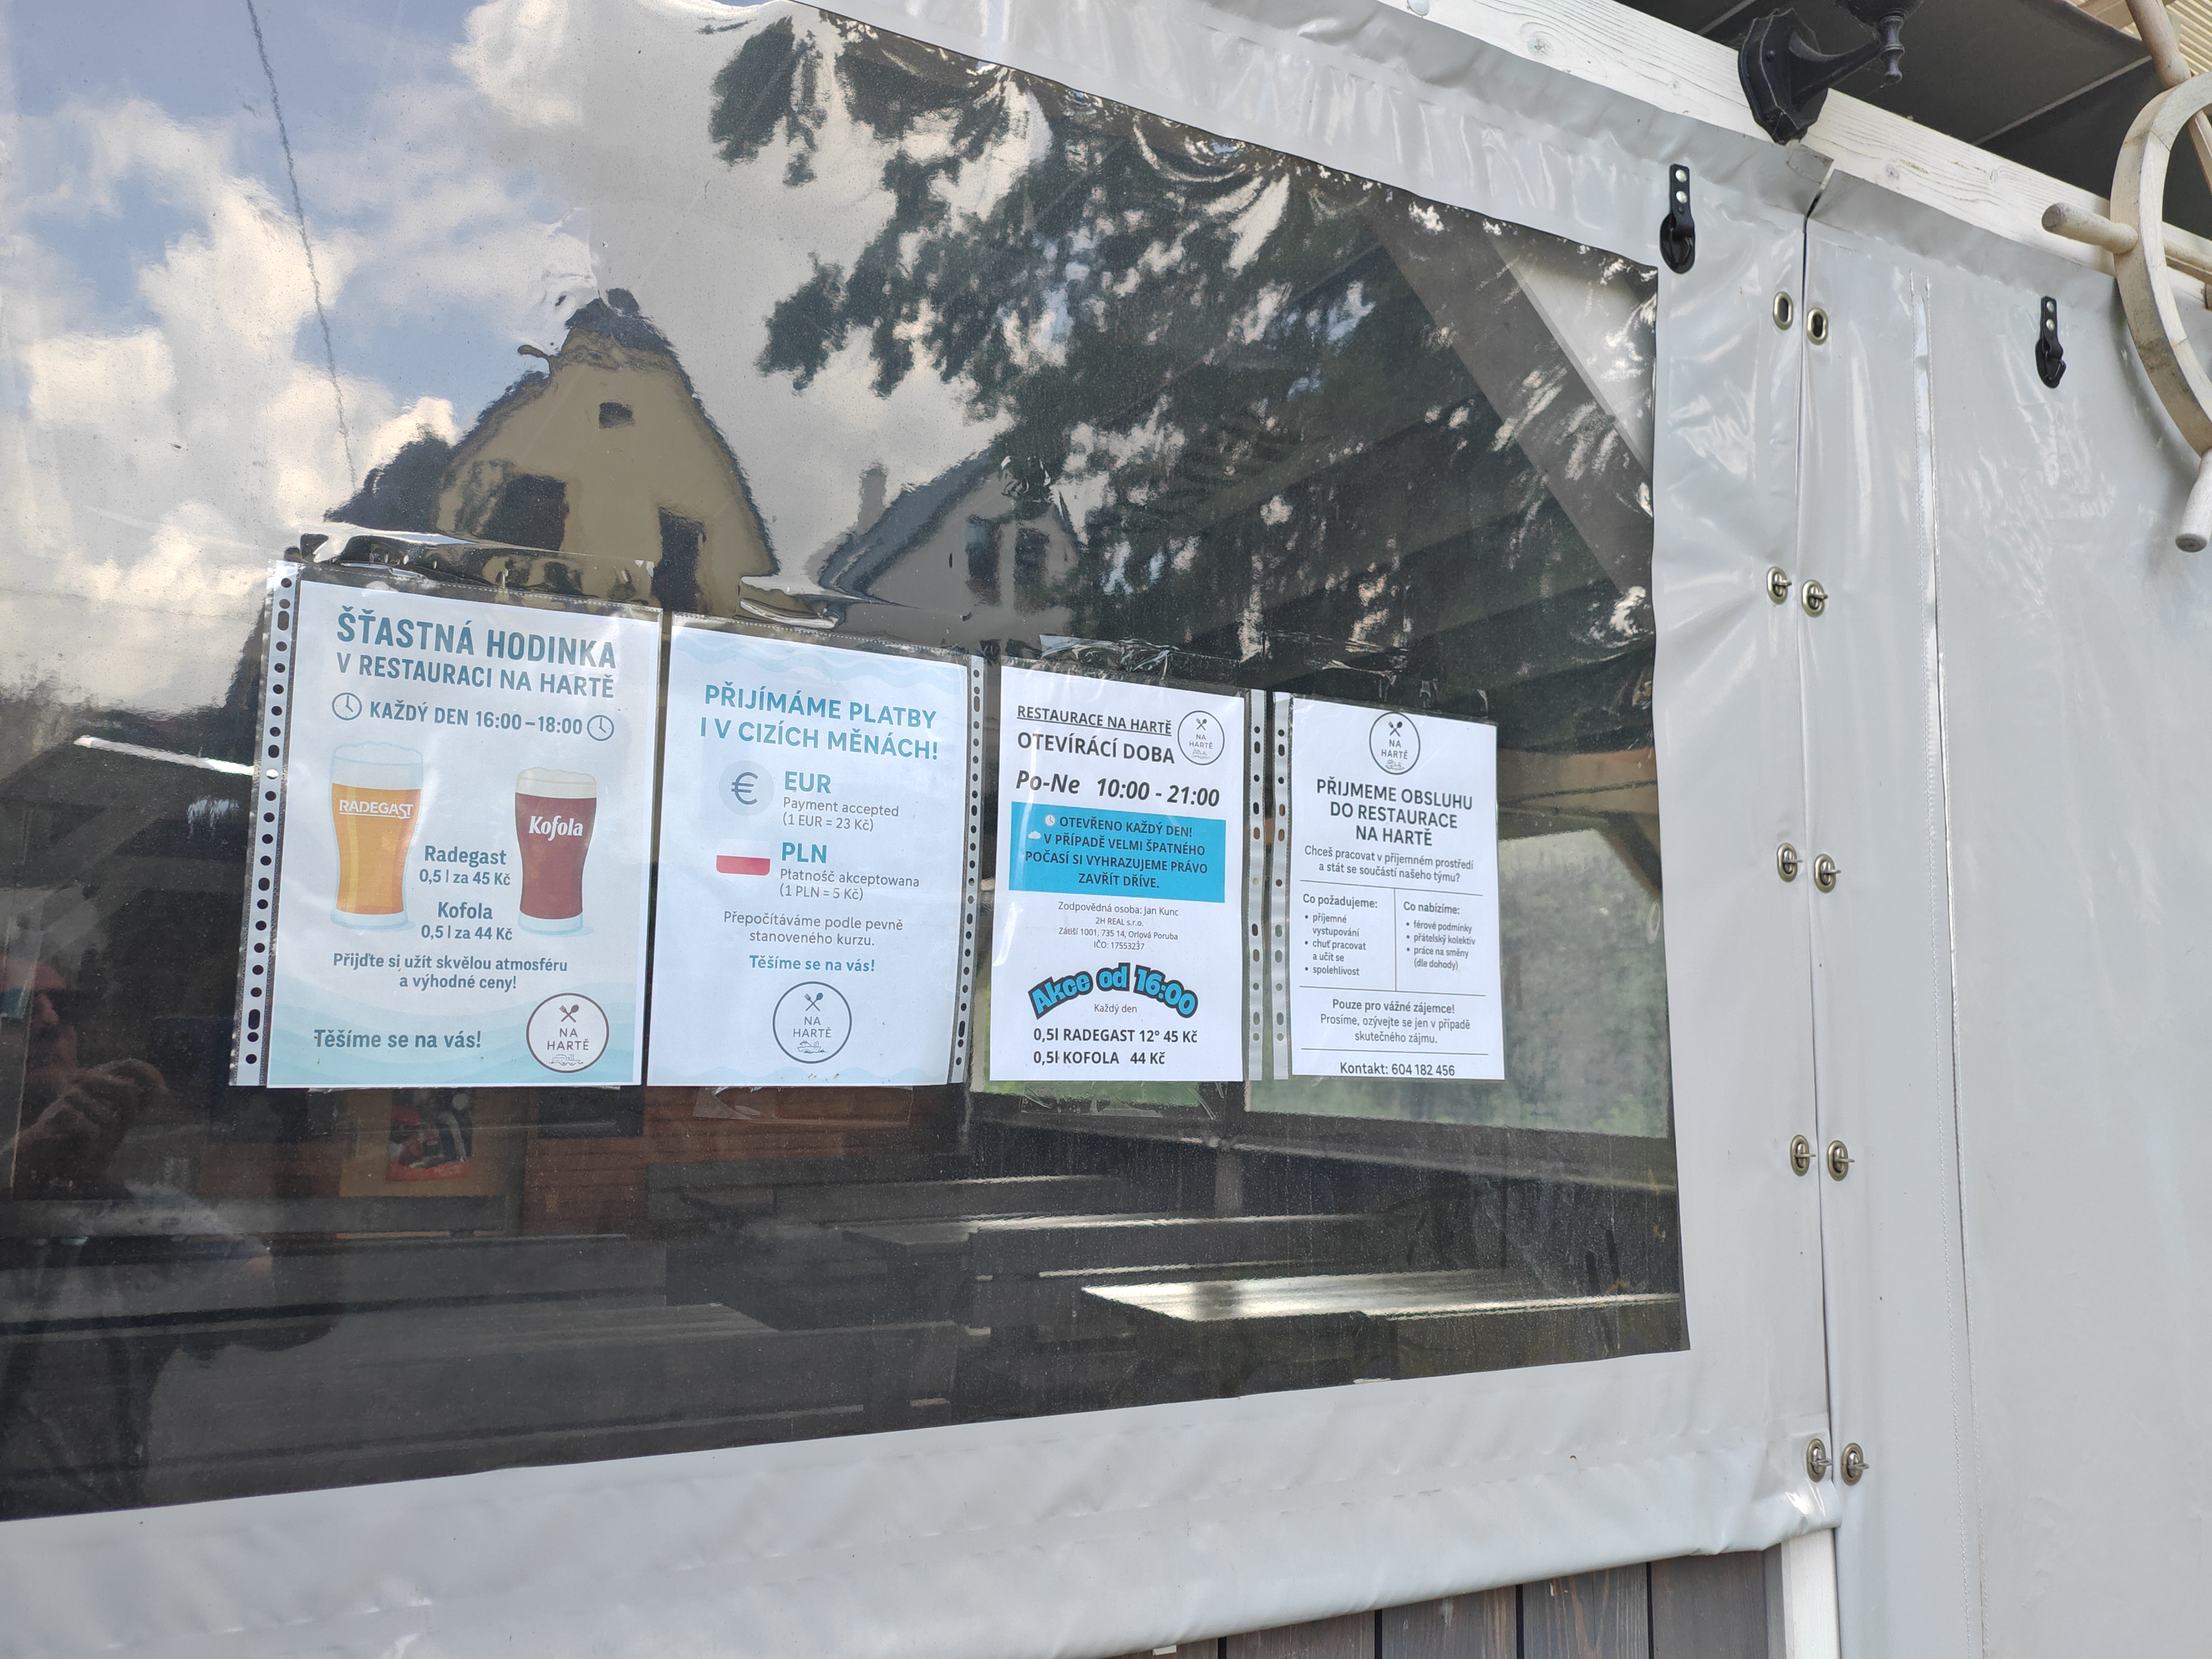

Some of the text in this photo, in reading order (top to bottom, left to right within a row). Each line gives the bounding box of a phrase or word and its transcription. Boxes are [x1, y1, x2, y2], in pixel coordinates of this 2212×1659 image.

[338, 605, 615, 668] ŠŤASTNÁ HODINKA
[337, 652, 613, 698] V RESTAURACI NA HARTĚ
[370, 699, 428, 721] KAŽDÝ
[435, 707, 468, 725] DEN
[705, 681, 936, 729] PŘIJÍMÁME PLATBY
[1017, 705, 1172, 734] RESTAURACE NA HARTĚ
[714, 719, 937, 760] V CIZÍCH MĚNÁCH!
[1018, 732, 1175, 764] OTEVÍRÁCÍ DOBA
[1389, 739, 1401, 748] NA
[1381, 749, 1408, 759] HARTĚ
[785, 771, 831, 793] EUR
[1016, 770, 1219, 807] Po-Ne 10:00 21:00
[1317, 777, 1472, 810] PŘIJMEME OBSLUHU
[339, 799, 414, 819] RADEGAST
[784, 797, 899, 817] Payment accepted
[1331, 801, 1457, 828] DO RESTAURACE
[529, 815, 583, 841] Kofola
[783, 812, 873, 832] (1 EUR 23 Kč)
[1060, 816, 1192, 837] OTEVŘENO KAŽDÝ DEN!
[1043, 832, 1205, 855] V PŘÍPADĚ VELMI ŠPATNÉHO
[1357, 826, 1432, 846] NA HARTĚ
[425, 846, 507, 868] Radegast
[782, 842, 826, 863] PLN
[1026, 849, 1207, 873] POČASÍ SI VYHRAZUJEME PRÁVO
[1305, 845, 1473, 869] Chceš pracovat příjemném prostředí
[420, 869, 510, 886] 0,5 za 45 Kč
[839, 871, 919, 887] akceptowana
[1078, 872, 1159, 888] ZAVŘÍT DŘÍVE.
[1327, 862, 1460, 883] stát součástí našeho týmu?
[780, 883, 863, 901] (1 PLN Kč)
[1058, 901, 1179, 916] Zodpovědná osoba: Jan Kunc
[1303, 894, 1378, 909] Co požadujeme:
[1404, 901, 1460, 914] Co nabízíme:
[438, 902, 493, 919] Kofola
[1313, 913, 1346, 924] příjemné
[724, 911, 902, 932] Přepočítáváme podle pevně
[1108, 918, 1125, 926] REAL
[1413, 920, 1472, 934] férové podmínky
[421, 925, 512, 940] 0,5 za 44 Kč
[750, 931, 874, 946] stanoveného kurzu.
[1313, 927, 1359, 938] vystupování
[1448, 935, 1475, 945] kolektiv
[1111, 941, 1144, 950] 17553237
[1313, 939, 1366, 950] chuť pracovat
[1414, 946, 1433, 955] práce
[334, 953, 567, 971] Přijďte si užít skvělou atmosféru
[749, 955, 874, 972] Těšíme se na vás!
[1313, 965, 1359, 975] spolehlivost
[1429, 960, 1458, 970] dohody)
[413, 974, 516, 993] výhodné ceny!
[1028, 962, 1198, 1021] Akce od 16:00
[1095, 1003, 1137, 1015] Každý den
[1333, 999, 1454, 1015] Pouze pro vážné zájemce!
[805, 1016, 821, 1026] NA
[1321, 1014, 1470, 1031] Prosíme, ozývejte jen případě
[314, 1029, 481, 1048] Těšíme se na vás!
[559, 1028, 578, 1037] NA
[793, 1027, 831, 1037] HARTĚ
[1034, 1028, 1058, 1042] 0,5l
[1064, 1029, 1135, 1041] RADEGAST
[1163, 1030, 1178, 1042] 45
[1183, 1030, 1197, 1043] Kč
[1355, 1030, 1437, 1046] skutečného zájmu.
[547, 1038, 589, 1050] HARTĚ
[1034, 1050, 1165, 1065] 0,5l KOFOLA 44 Kč
[1340, 1062, 1455, 1076] Kontakt: 604 182 456
